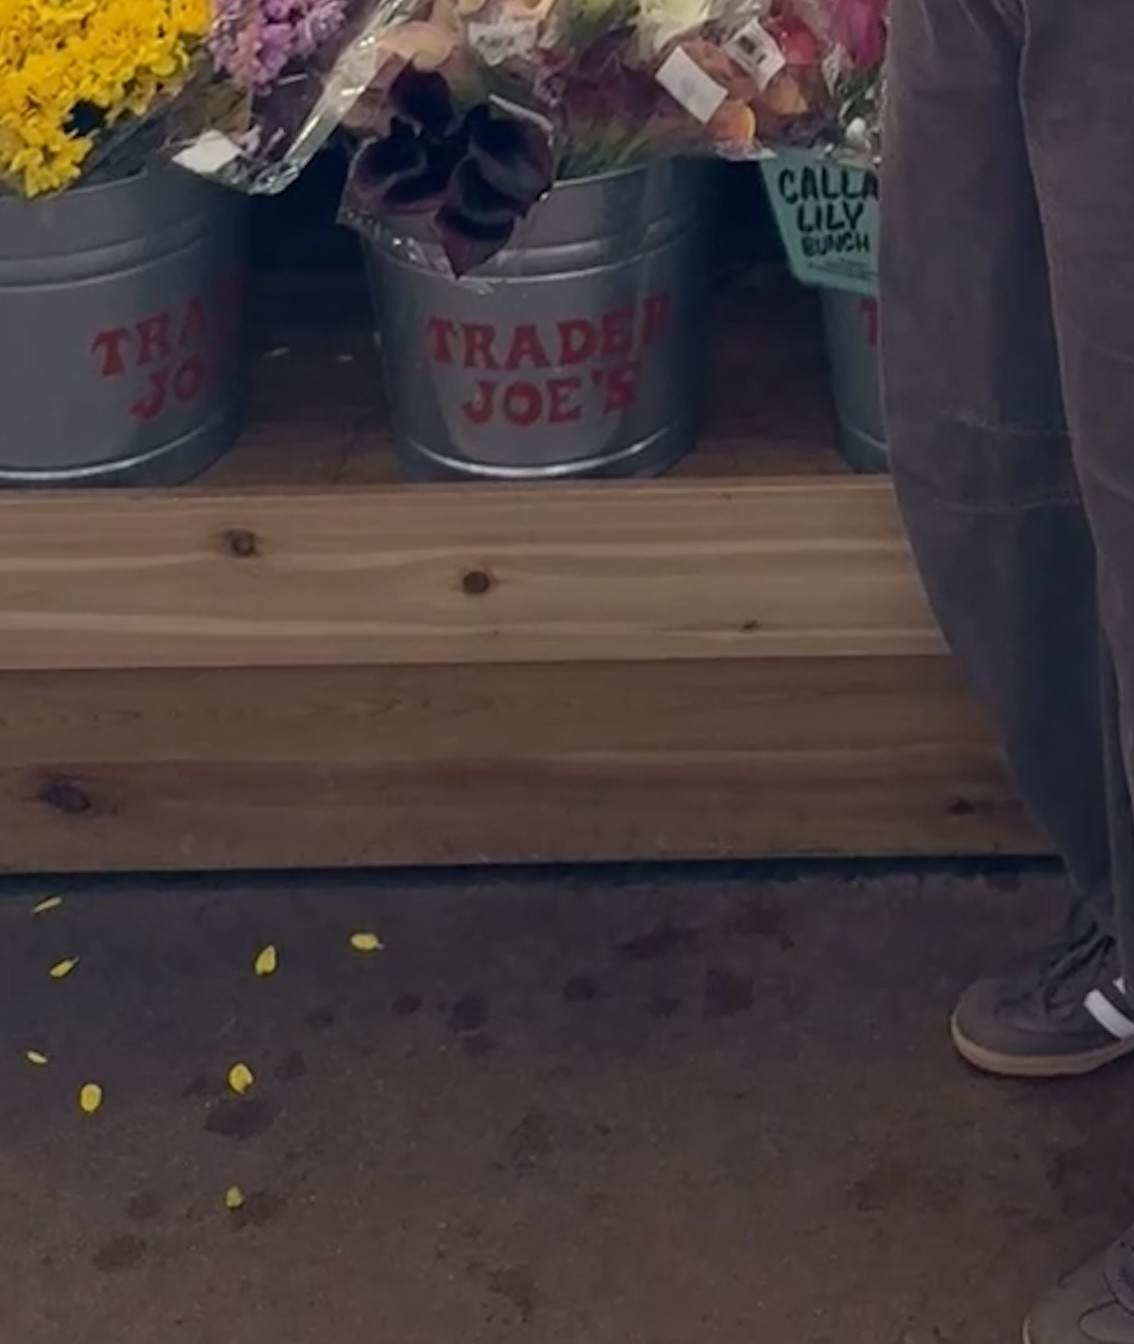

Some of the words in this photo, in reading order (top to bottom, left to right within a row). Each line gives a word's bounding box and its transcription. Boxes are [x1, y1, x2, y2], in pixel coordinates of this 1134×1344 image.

[778, 165, 879, 205] CALLA
[797, 202, 864, 232] LILY
[802, 233, 870, 257] BUNCH
[429, 292, 671, 370] TRADER
[460, 361, 641, 427] JOE'S
